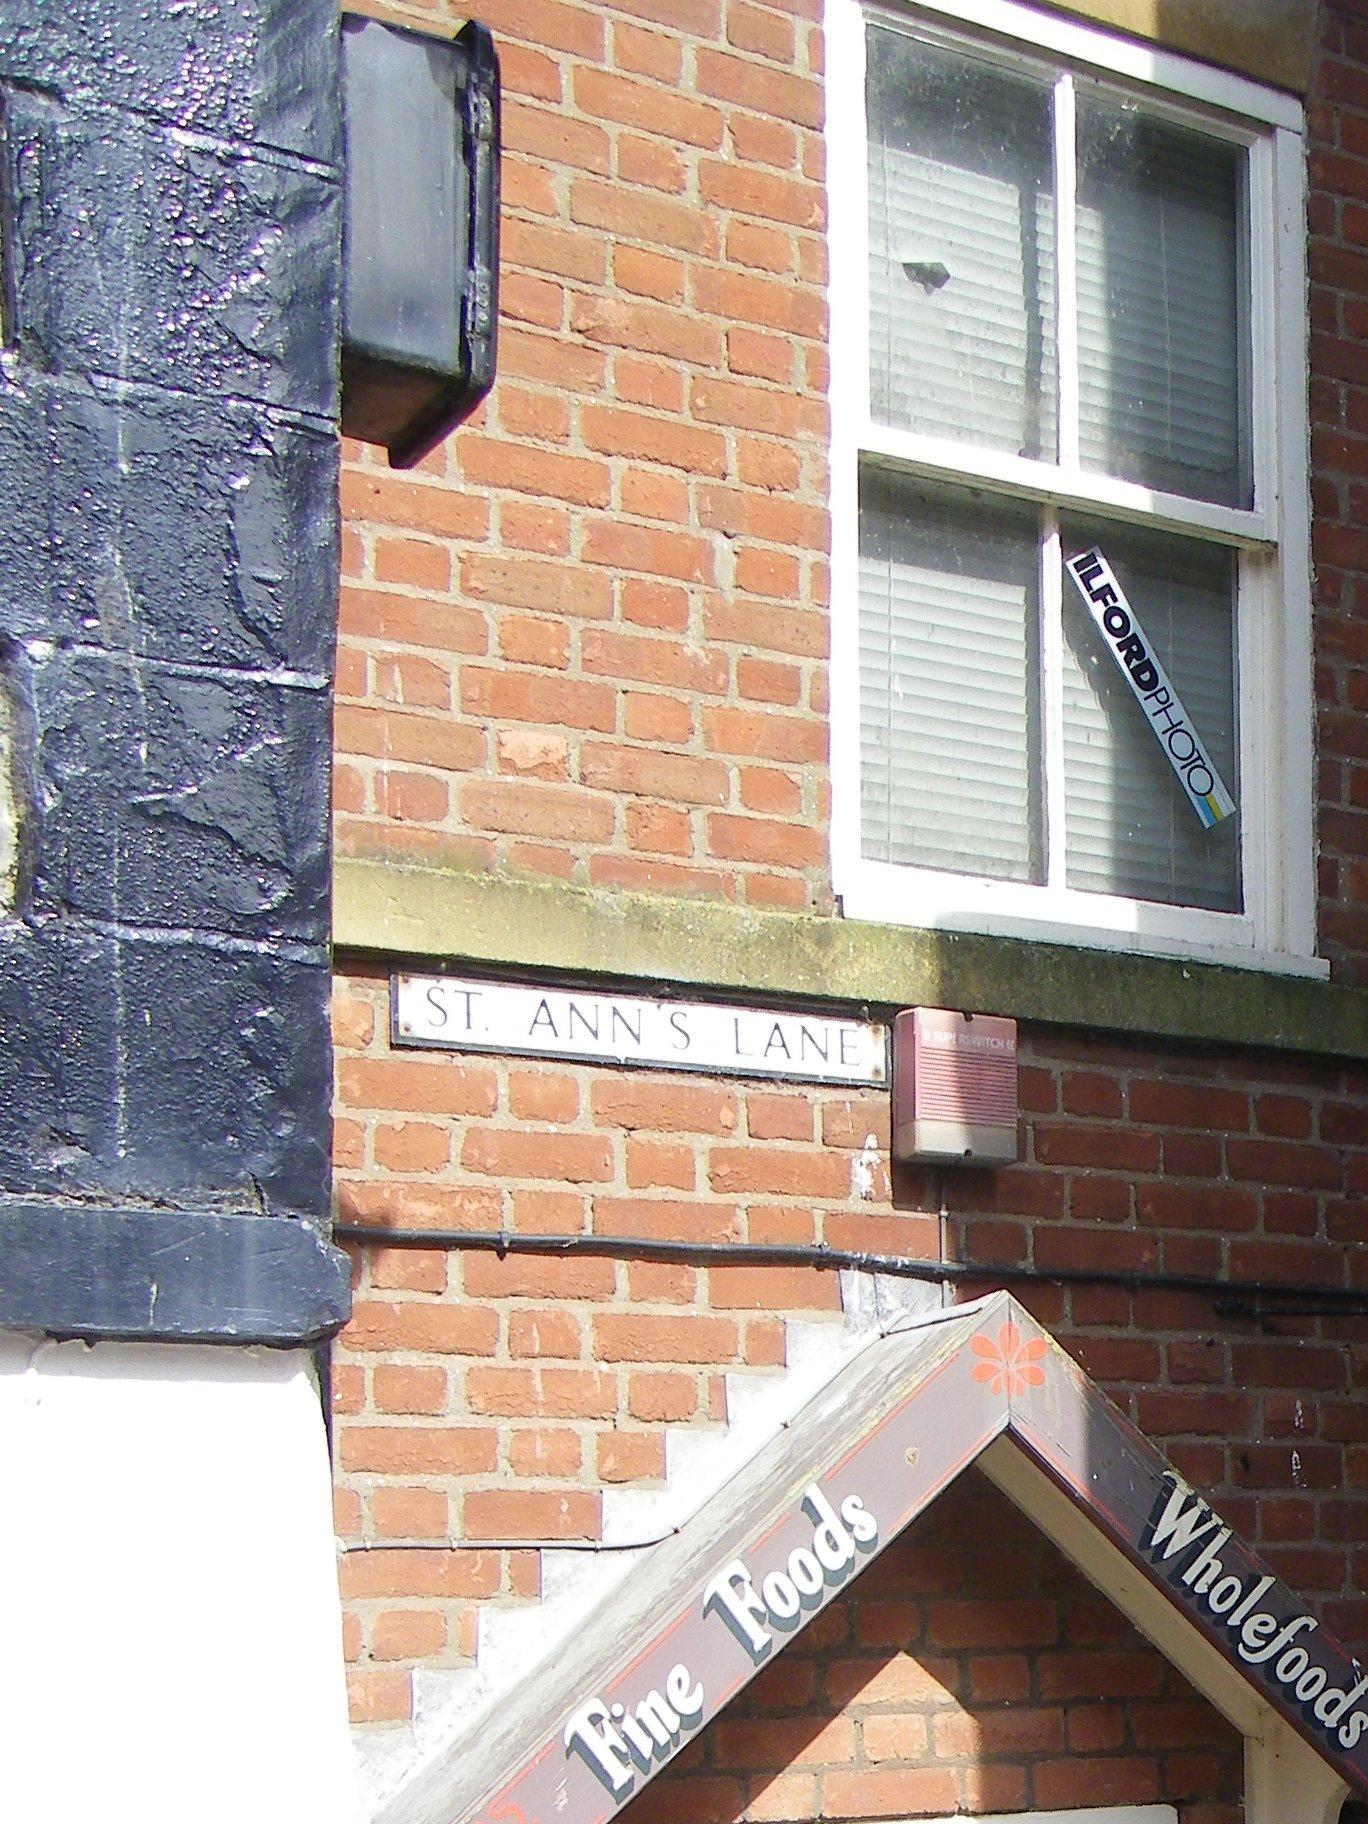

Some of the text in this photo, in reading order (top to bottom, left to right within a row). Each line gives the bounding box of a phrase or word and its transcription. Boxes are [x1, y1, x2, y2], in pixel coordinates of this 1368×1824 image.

[426, 986, 861, 1067] ST. ANN'S LANE
[565, 1483, 880, 1802] Fine Foods
